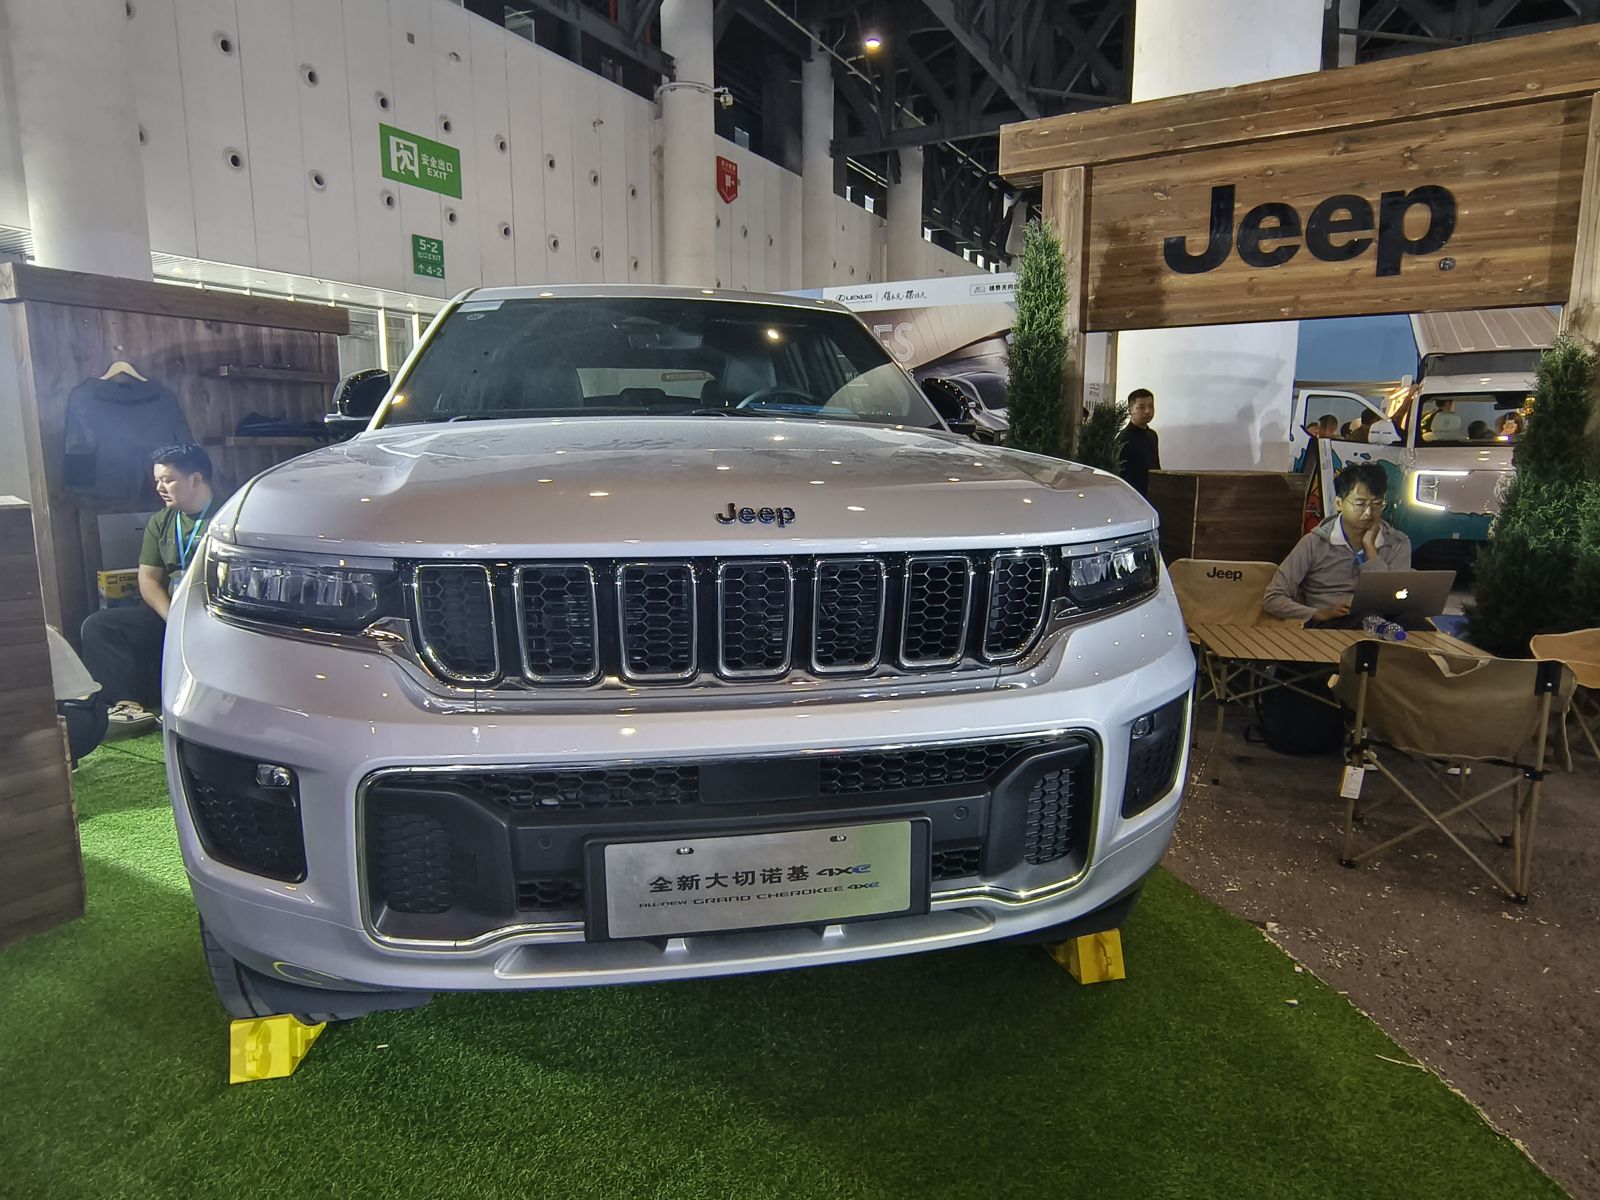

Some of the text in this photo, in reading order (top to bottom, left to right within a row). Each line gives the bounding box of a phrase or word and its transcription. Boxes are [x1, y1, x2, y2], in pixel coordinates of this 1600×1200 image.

[421, 153, 454, 173] 安全出口
[426, 167, 448, 181] EXIT
[1163, 183, 1457, 277] Jeep
[419, 239, 439, 254] 5-2
[845, 293, 873, 301] LEXUS
[715, 502, 796, 528] Jeep
[1206, 566, 1243, 581] Jeep
[649, 864, 810, 893] 全新大切诺基
[693, 895, 751, 905] GRAND
[756, 885, 845, 900] CHEROKEE
